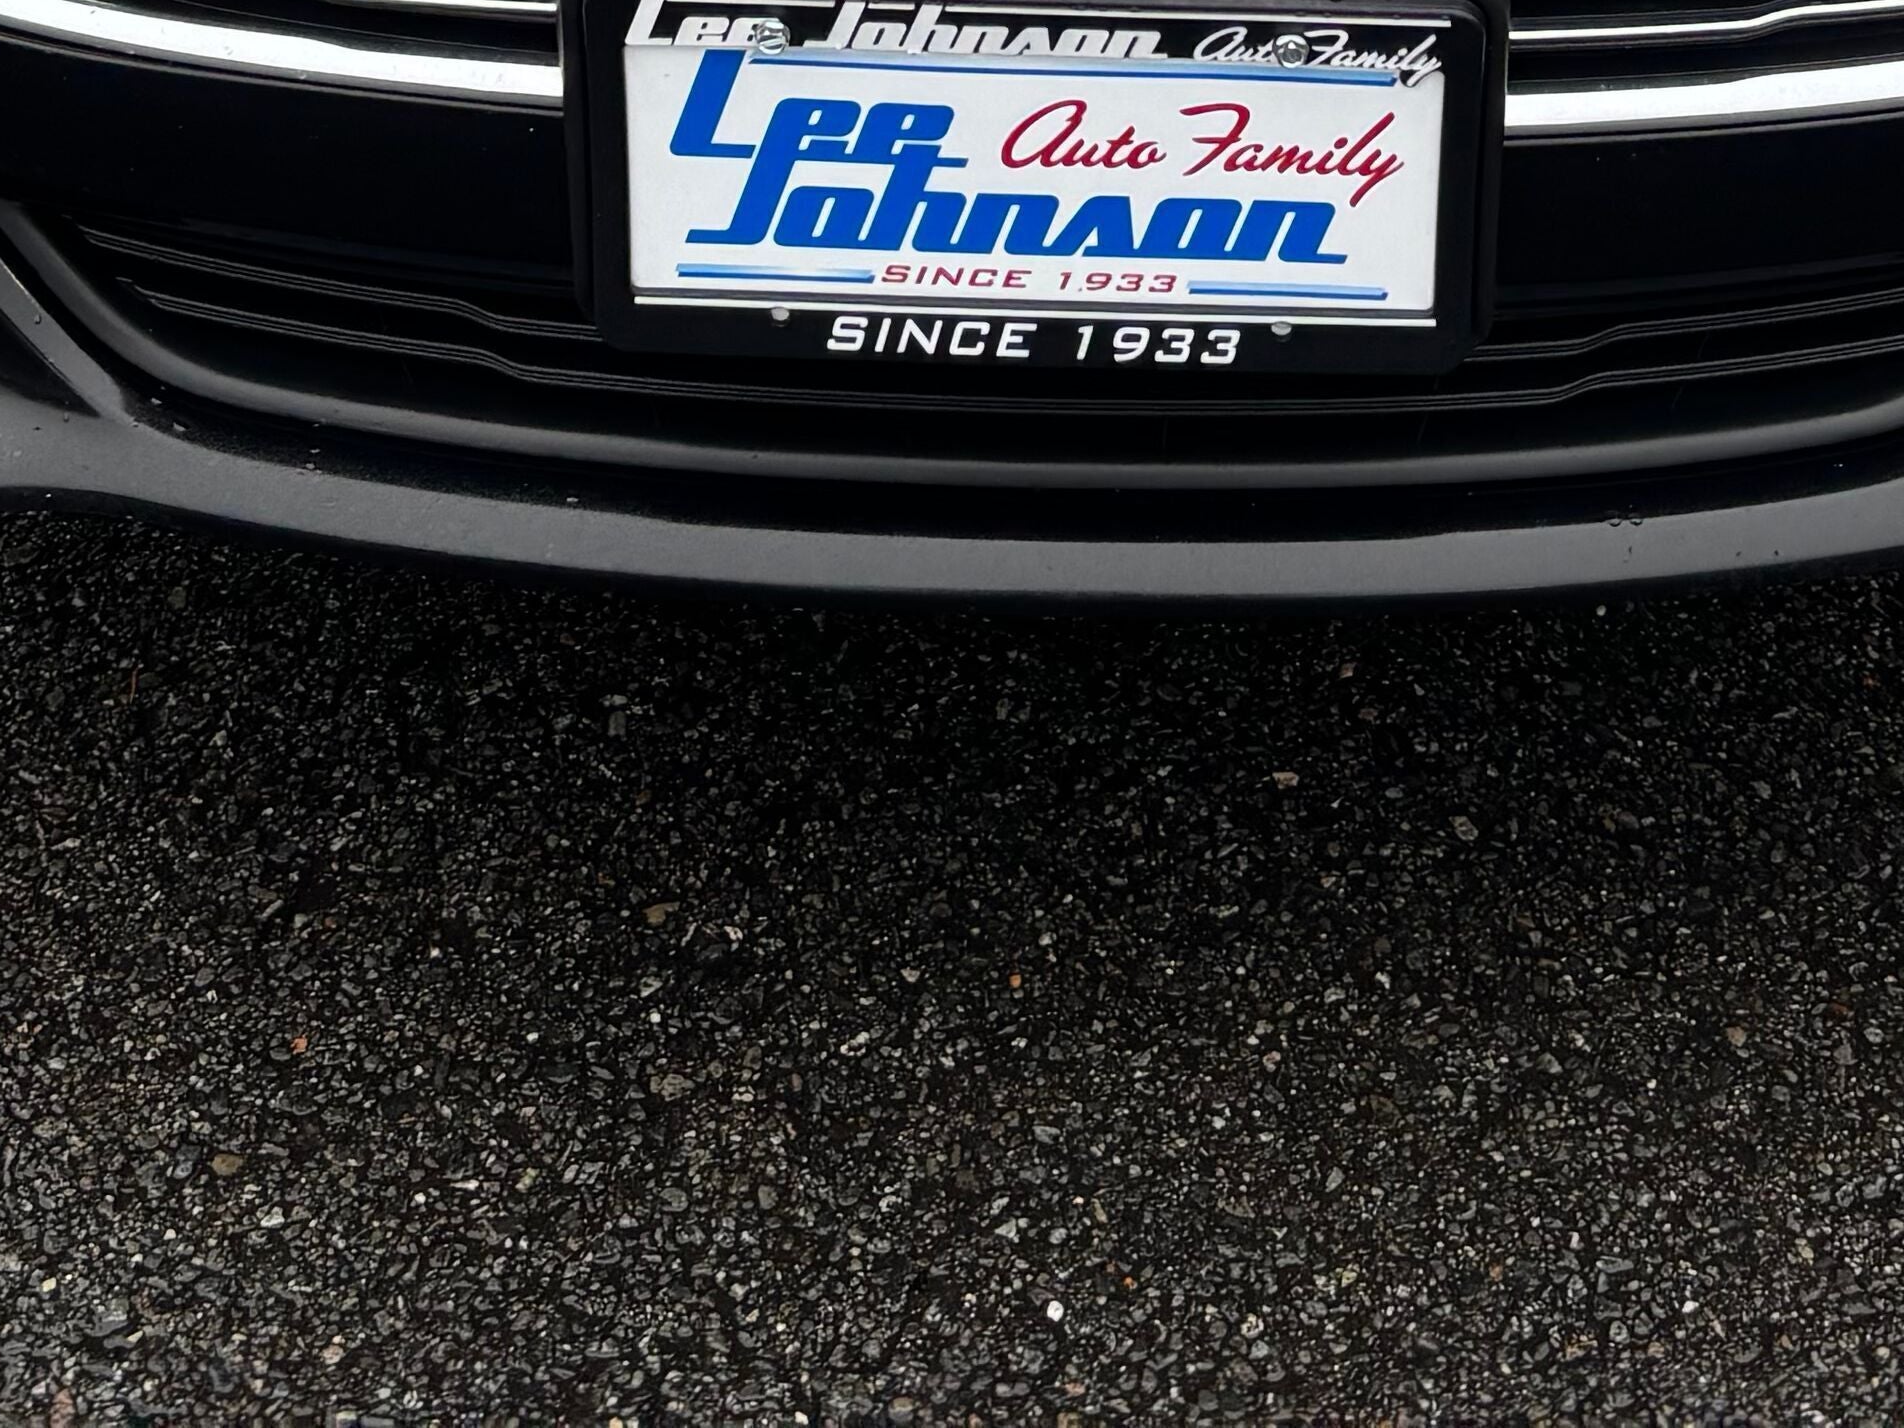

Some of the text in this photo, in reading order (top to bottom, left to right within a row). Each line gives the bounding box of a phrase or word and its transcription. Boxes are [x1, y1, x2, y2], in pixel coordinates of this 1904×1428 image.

[802, 0, 1169, 59] Johnson
[1193, 26, 1278, 64] Aut
[1302, 28, 1442, 88] Family
[669, 48, 1405, 208] Lee Auto Family
[684, 154, 1348, 265] Johnson
[880, 264, 1179, 293] SINCE 1933
[826, 315, 1242, 365] SINCE 1933
